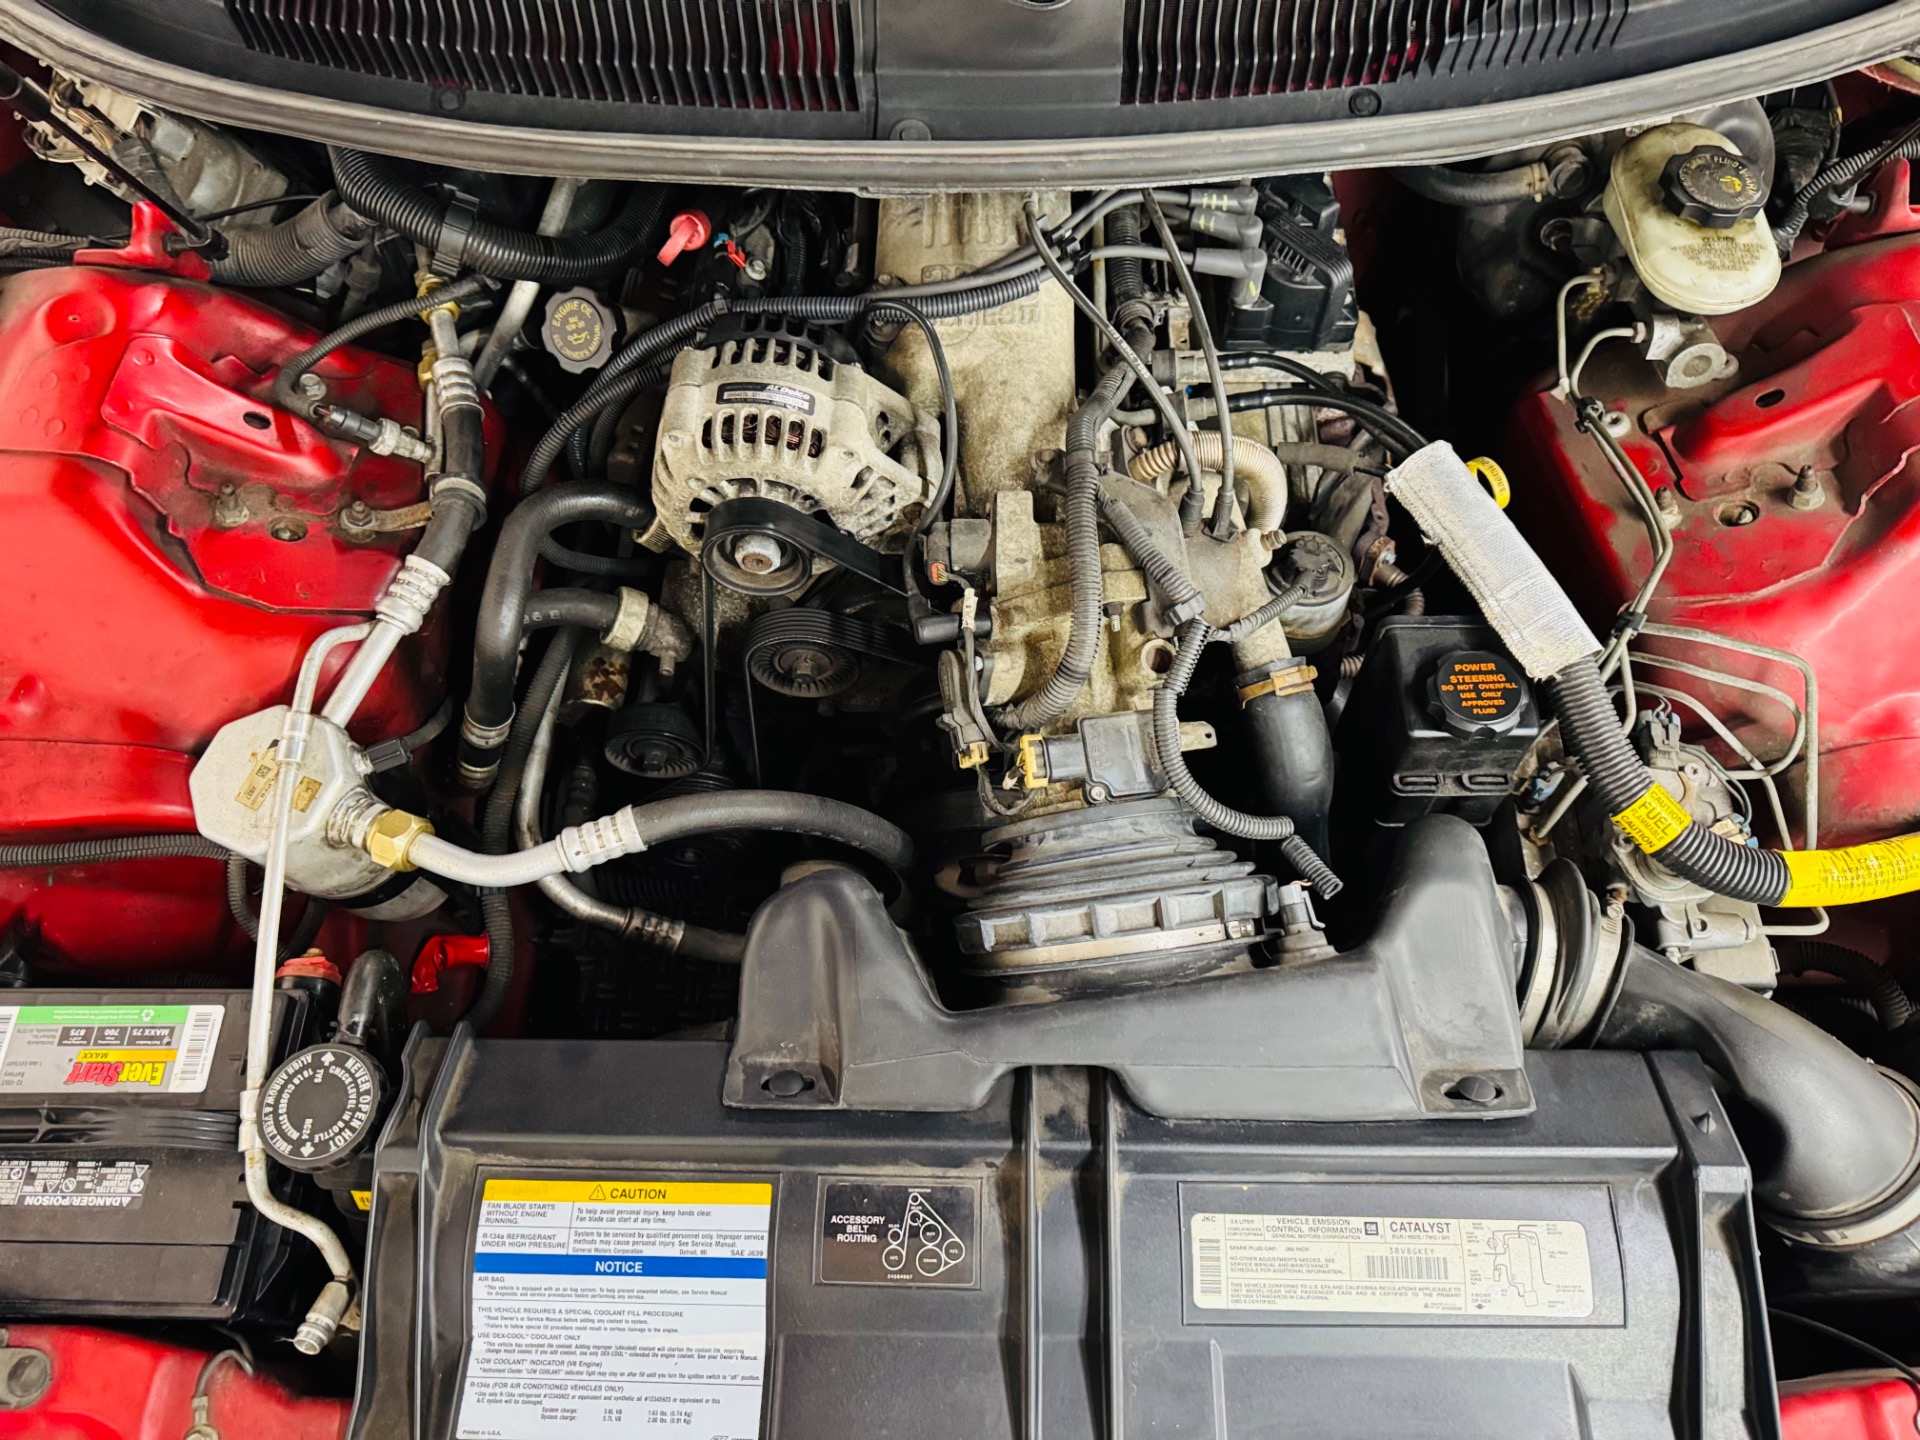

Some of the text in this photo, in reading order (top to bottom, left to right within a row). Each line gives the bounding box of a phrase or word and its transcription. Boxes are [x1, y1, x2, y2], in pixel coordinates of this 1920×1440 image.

[552, 301, 580, 327] ENGINE
[581, 304, 592, 318] OIL
[1450, 674, 1506, 683] STEERING
[1454, 663, 1496, 672] POWER
[1638, 801, 1672, 836] FUEL
[1650, 791, 1684, 825] CAUTION
[1621, 815, 1655, 848] CAUTION
[1631, 808, 1665, 842] FLAMMABLE
[67, 1062, 166, 1086] EverStart
[287, 1054, 313, 1075] ALIGN
[267, 1074, 288, 1105] ARROW
[292, 1074, 304, 1085] LB
[278, 1084, 295, 1113] CLOSED
[314, 1066, 357, 1143] CHECK LEVEL IN BOTTLE
[329, 1058, 371, 1152] NEVER OPEN HOT
[264, 1115, 278, 1137] VENT
[279, 1114, 300, 1140] SYSTEM
[24, 1196, 121, 1206] DANGER/POISON
[610, 1188, 666, 1199] CAUTION
[830, 1215, 885, 1224] ACCESSORY
[1389, 1221, 1450, 1233] CATALYST
[837, 1234, 877, 1243] ROUTING
[595, 1261, 642, 1273] NOTICE
[578, 1360, 602, 1368] Engine)
